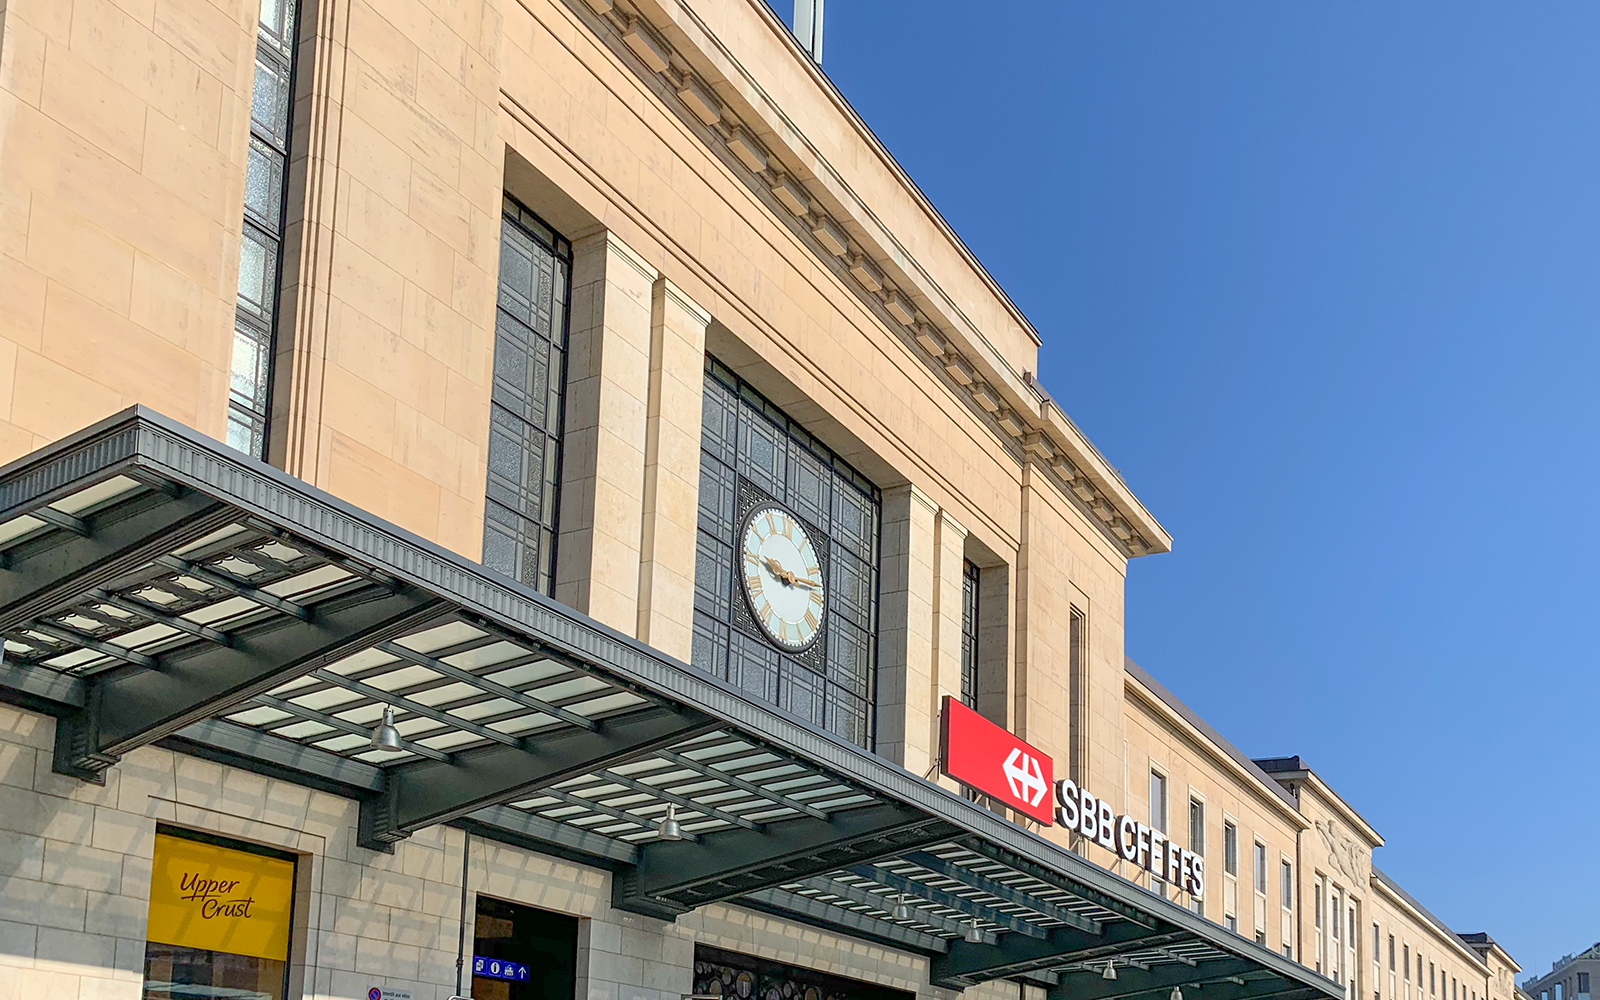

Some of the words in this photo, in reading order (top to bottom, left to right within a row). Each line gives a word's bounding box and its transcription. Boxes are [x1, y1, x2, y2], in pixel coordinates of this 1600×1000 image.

[1059, 779, 1115, 847] SBB
[1120, 814, 1164, 877] CFF
[1168, 839, 1204, 897] FFS
[180, 872, 240, 902] Upper
[202, 897, 255, 919] Crust
